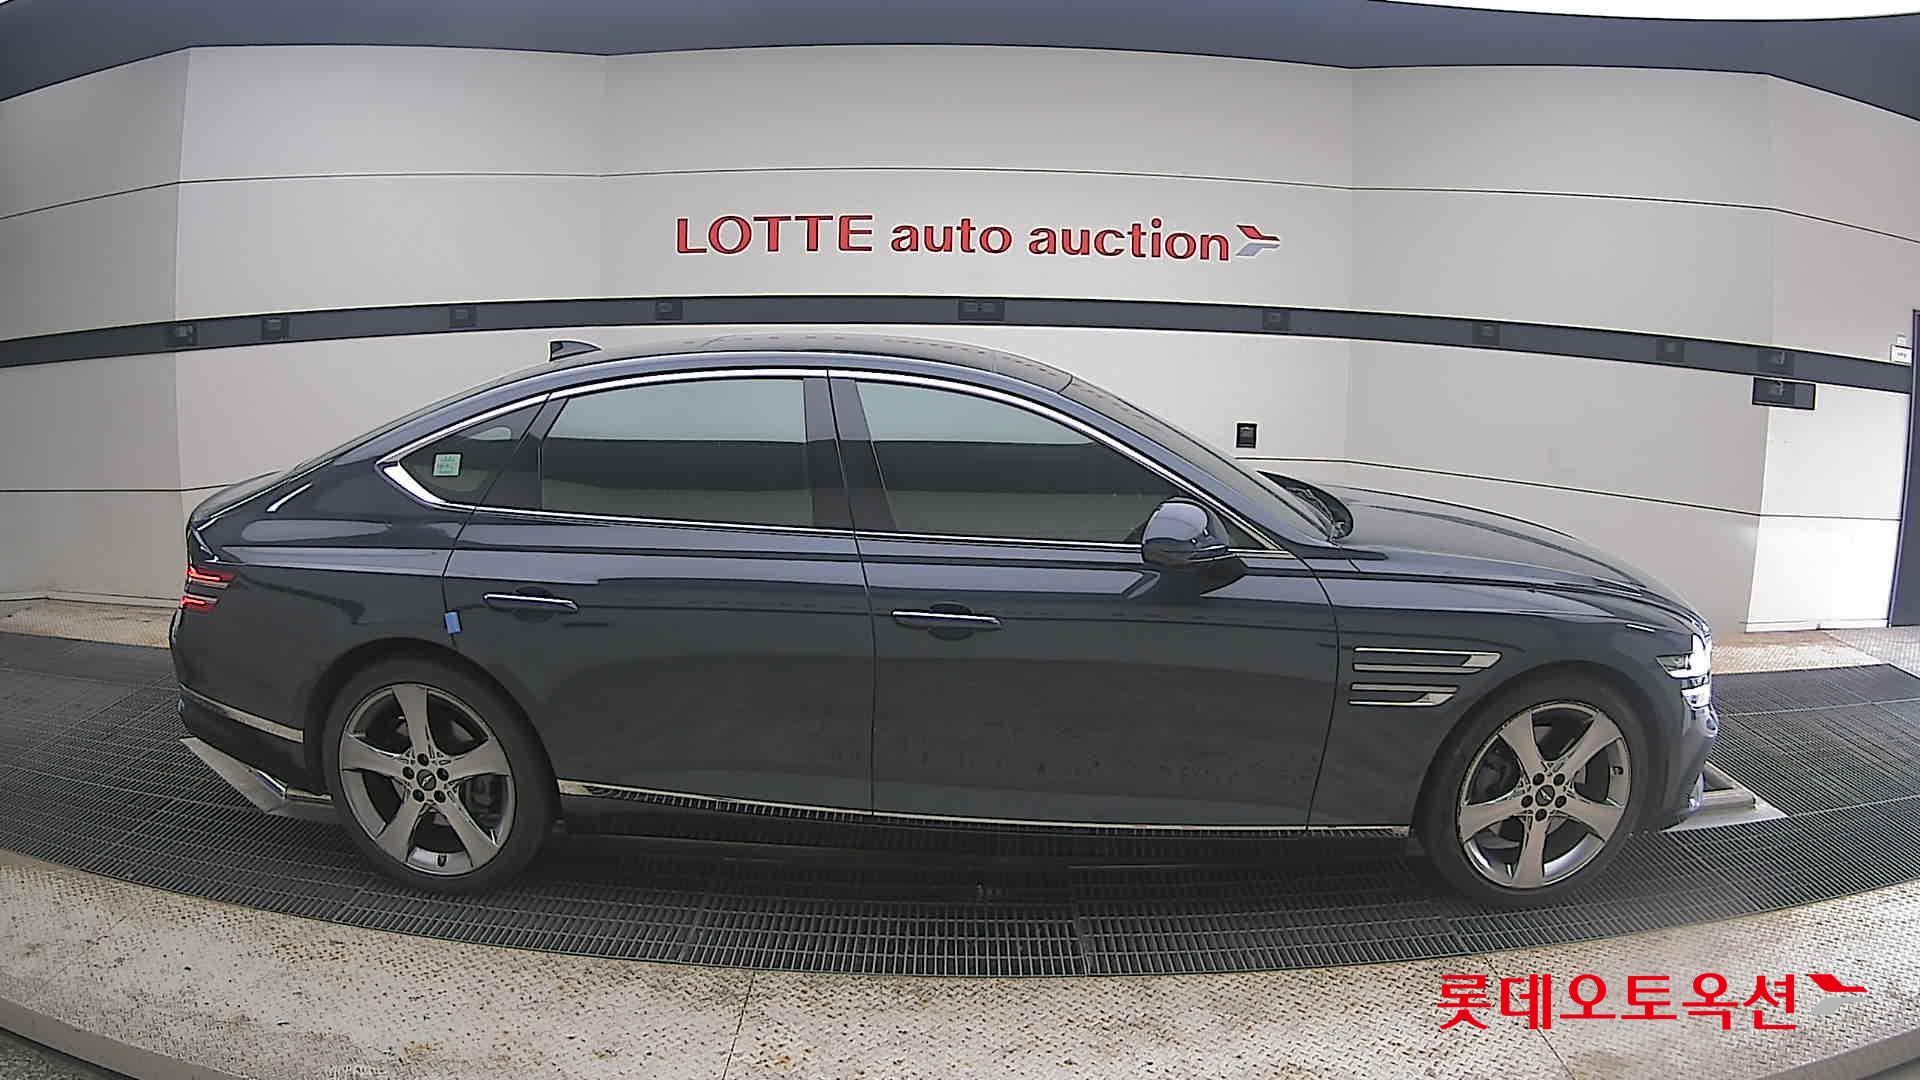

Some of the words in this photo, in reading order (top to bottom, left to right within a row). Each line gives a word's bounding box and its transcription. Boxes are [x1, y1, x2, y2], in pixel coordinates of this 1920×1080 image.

[676, 214, 873, 254] LOTTE
[891, 217, 1013, 253] auto
[1027, 216, 1230, 262] auction
